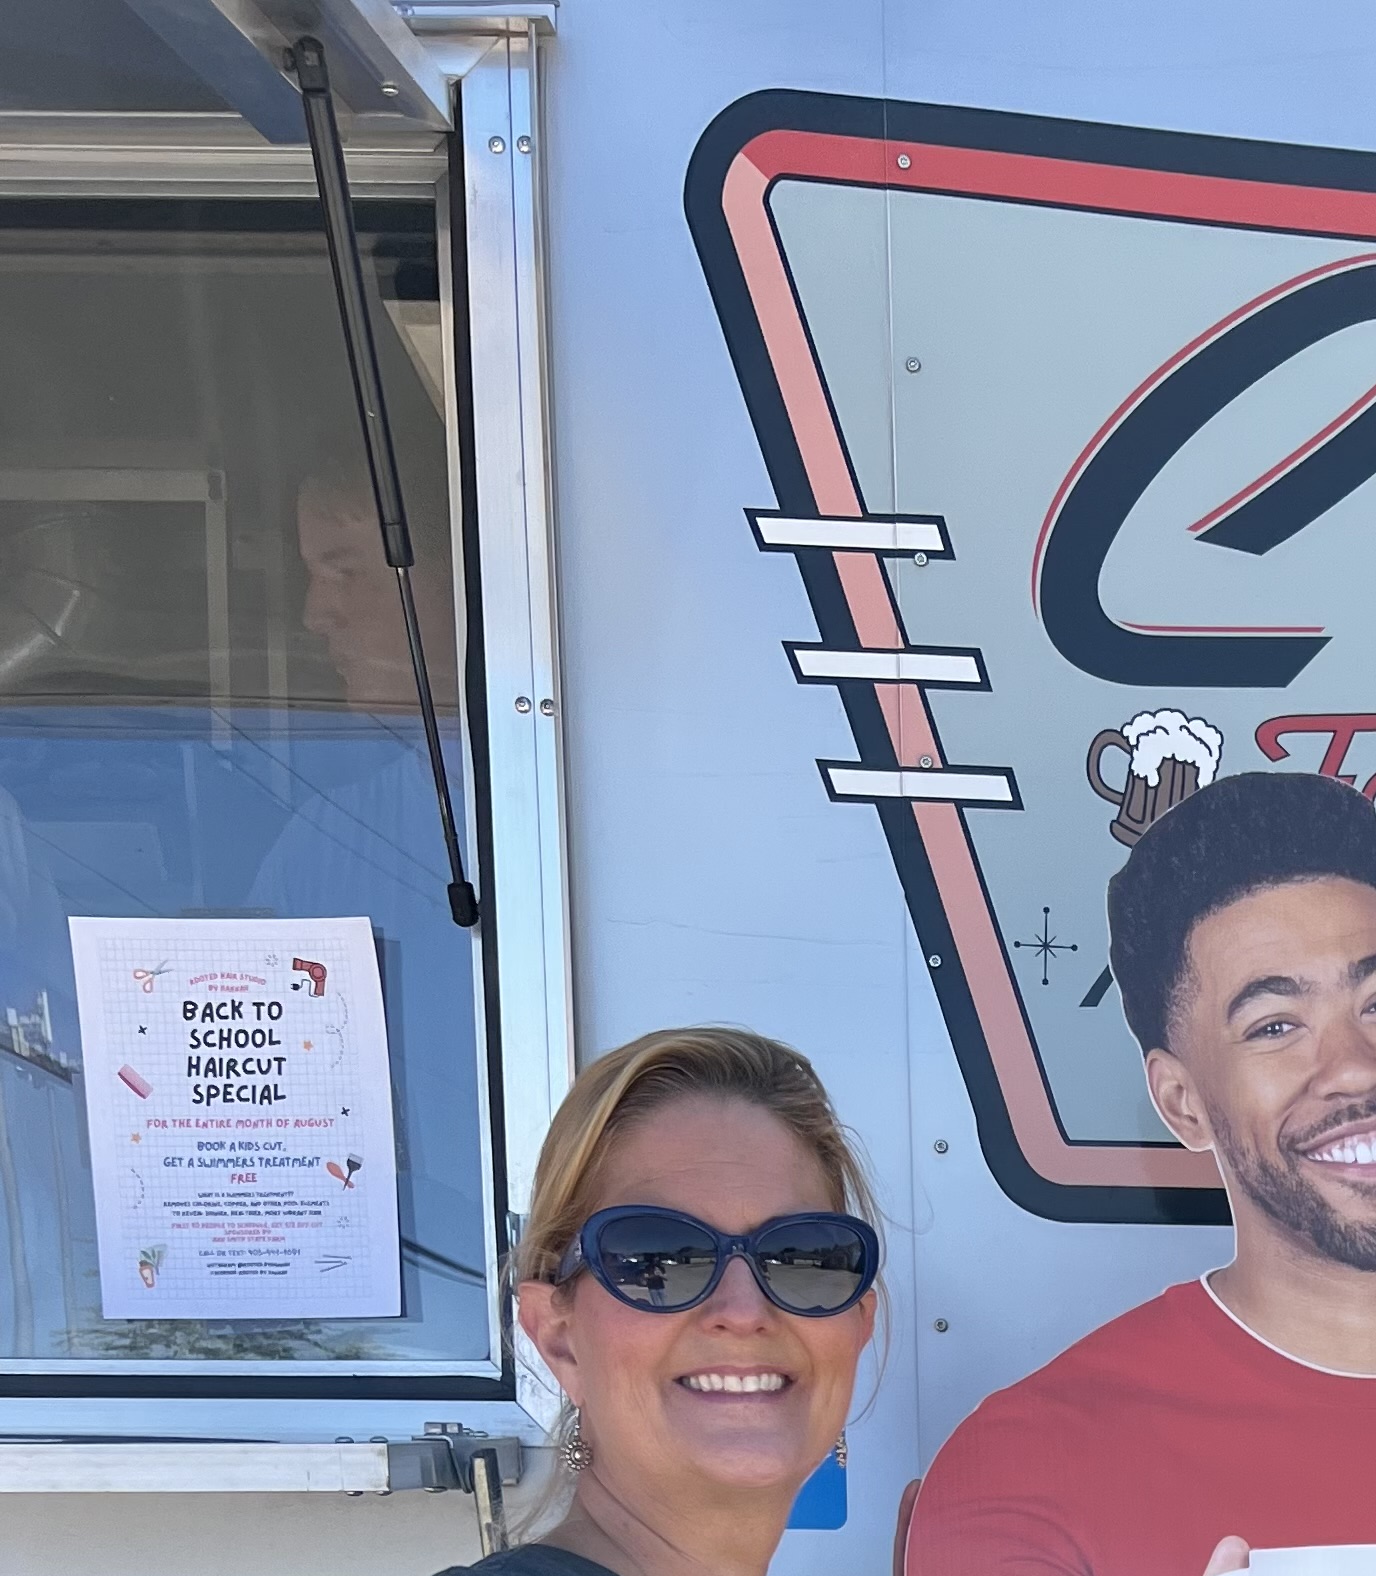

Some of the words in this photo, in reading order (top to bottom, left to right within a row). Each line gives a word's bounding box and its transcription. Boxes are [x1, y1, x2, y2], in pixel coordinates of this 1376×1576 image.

[182, 999, 243, 1023] BACK
[252, 1001, 283, 1021] TO
[189, 1028, 281, 1050] SCHOOL
[187, 1055, 287, 1079] HAIRCUT
[192, 1084, 287, 1106] SPECIAL
[146, 1119, 168, 1129] FOR
[172, 1119, 192, 1128] THE
[195, 1119, 232, 1129] ENTIRE
[235, 1118, 273, 1129] MONTH
[276, 1118, 290, 1128] OF
[294, 1118, 334, 1128] AUGUST
[197, 1141, 226, 1151] BOOK
[229, 1142, 236, 1152] A
[238, 1141, 260, 1152] KIDS
[163, 1156, 183, 1168] GET
[187, 1157, 195, 1168] A
[197, 1156, 255, 1168] SWIMMERS
[258, 1156, 321, 1168] TREATMENT
[231, 1172, 257, 1184] FREE
